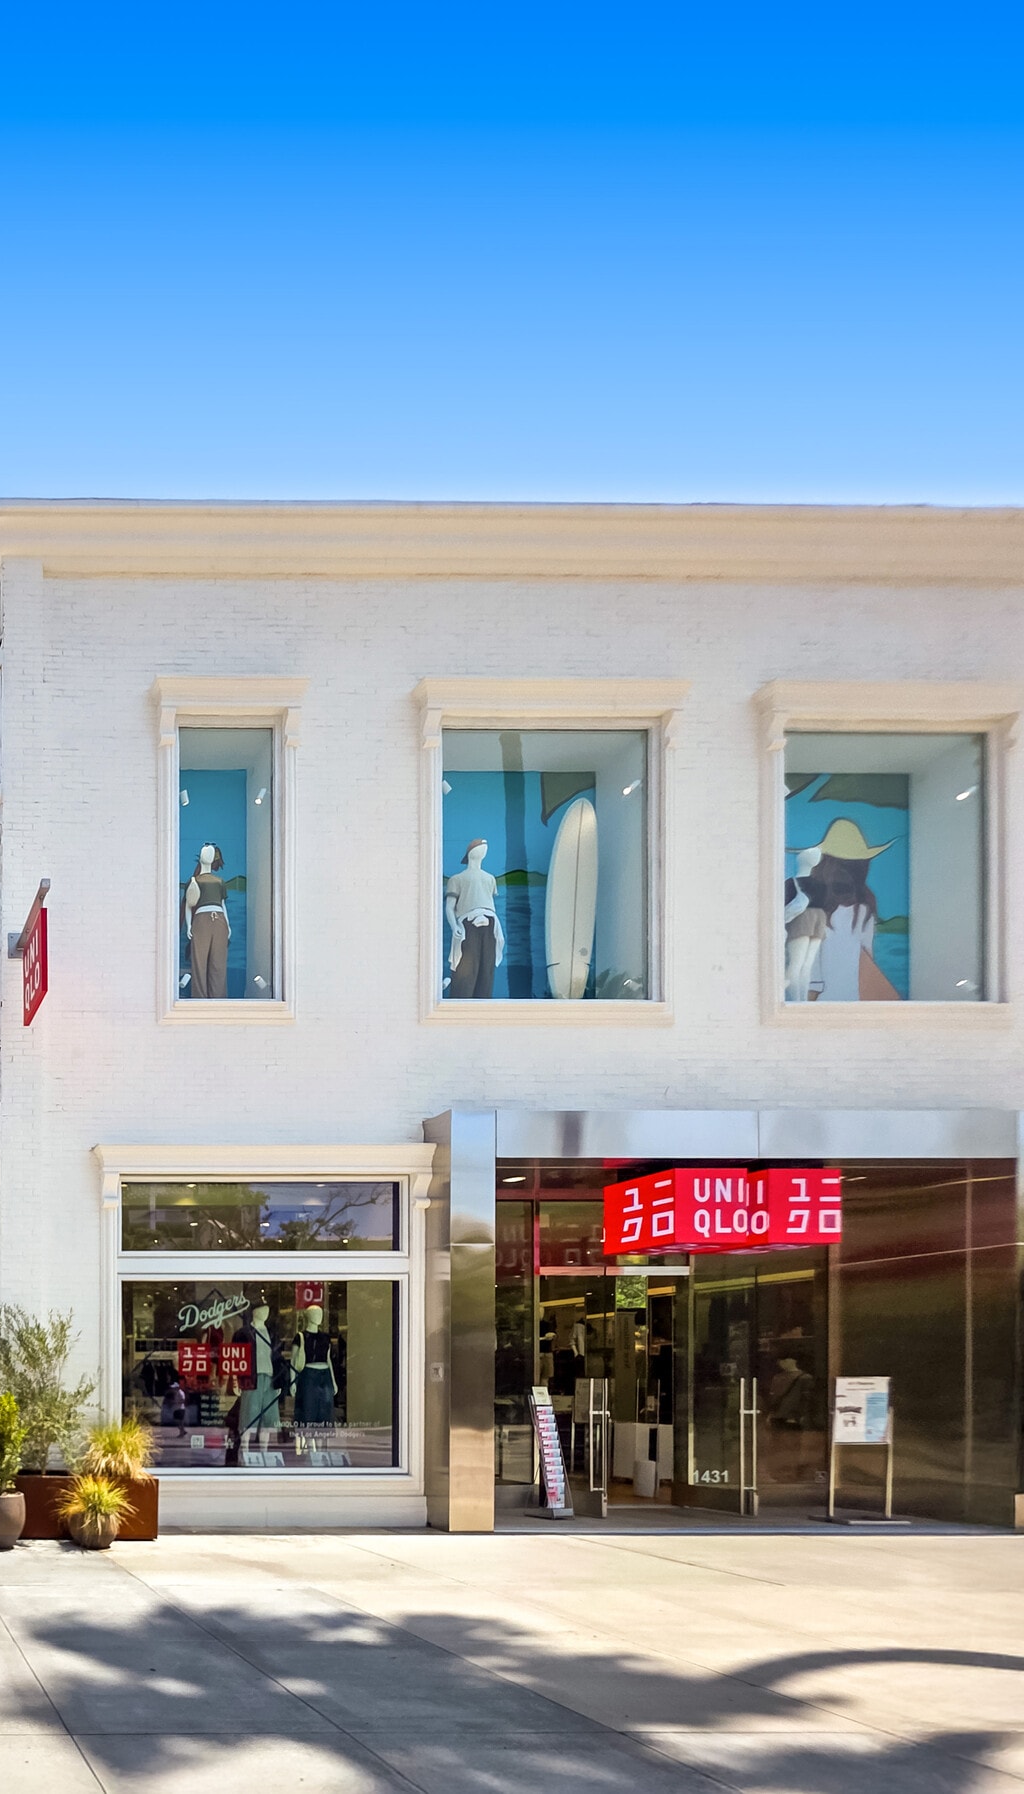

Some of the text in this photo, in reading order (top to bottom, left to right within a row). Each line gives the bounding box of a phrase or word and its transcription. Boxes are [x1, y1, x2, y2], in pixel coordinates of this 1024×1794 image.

[24, 929, 39, 978] UNI
[24, 962, 40, 1011] QLO
[622, 1179, 674, 1213] ユニ
[693, 1177, 744, 1203] UNI
[788, 1178, 841, 1203] ユニ
[693, 1208, 746, 1238] QLO
[178, 1291, 251, 1333] Dodgers
[222, 1347, 246, 1359] UNI
[222, 1360, 248, 1373] QLO
[306, 1421, 325, 1429] proud
[693, 1470, 728, 1483] 1431
